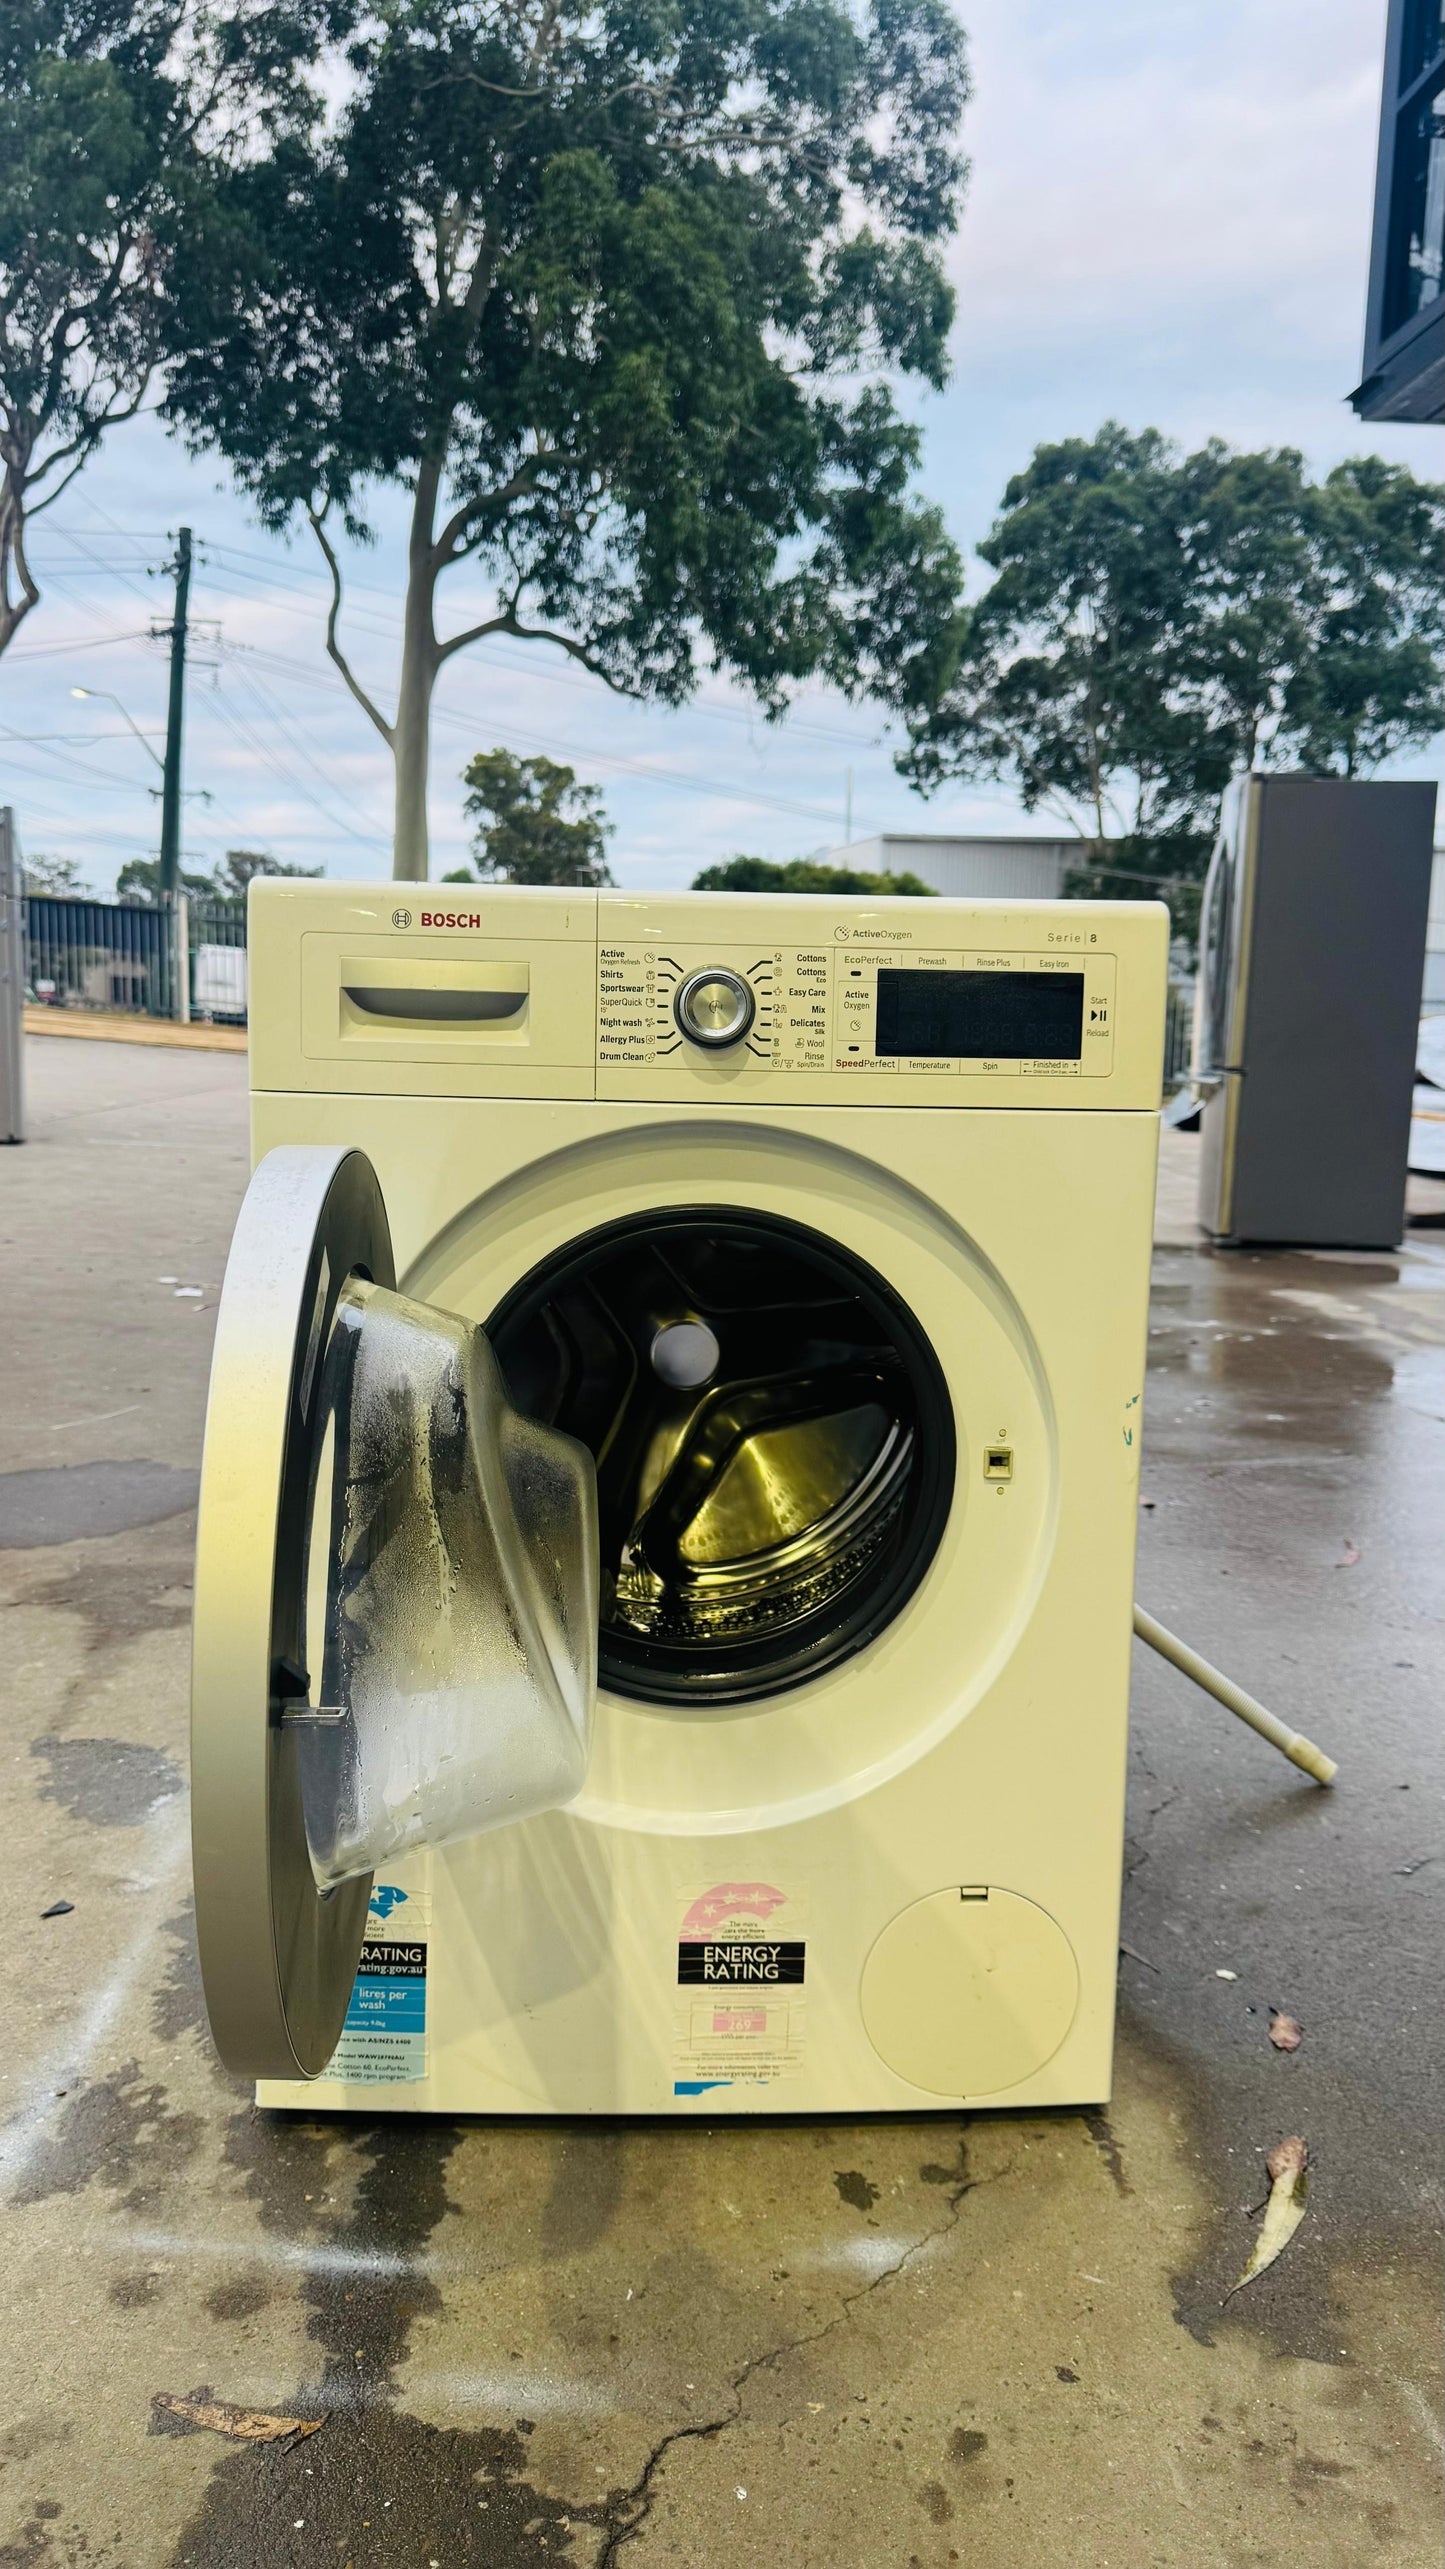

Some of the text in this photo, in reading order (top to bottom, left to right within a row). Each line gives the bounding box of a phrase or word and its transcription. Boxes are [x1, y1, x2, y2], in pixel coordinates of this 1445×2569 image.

[421, 912, 481, 928] BOSCH
[852, 929, 912, 940] ActiveOxygen
[1047, 932, 1097, 943] Serie 8
[600, 949, 625, 958] Active
[796, 954, 827, 963] Cottons
[844, 955, 892, 965] EcoPerfect
[918, 957, 947, 966] Prewash
[976, 958, 1011, 967] Rinse Plus
[1039, 960, 1069, 969] Easy Iron
[600, 970, 624, 979] Shirts
[796, 967, 827, 976] Cottons
[600, 984, 644, 993] Sportswear
[788, 988, 826, 997] Easy Care
[844, 990, 869, 999] Active
[600, 997, 643, 1006] SuperQuick
[1090, 996, 1108, 1005] Start
[811, 1005, 826, 1014] Mix
[843, 1001, 870, 1011] Oxygen
[600, 1018, 642, 1028] Night wash
[790, 1018, 825, 1028] Delicates
[1086, 1029, 1109, 1037] Reload
[600, 1035, 645, 1045] Allergy Plus
[806, 1039, 825, 1047] Wool
[600, 1052, 644, 1061] Drum Clean
[804, 1052, 825, 1060] Rinse
[835, 1059, 895, 1068] SpeedPerfect
[909, 1060, 951, 1070] Temperature
[982, 1062, 998, 1071] Spin
[1032, 1061, 1061, 1069] Finished
[360, 1946, 422, 1962] RATING
[703, 1946, 781, 1963] ENERGY
[703, 1963, 779, 1980] RATING
[358, 1987, 408, 2002] litres per
[358, 2000, 386, 2010] wash
